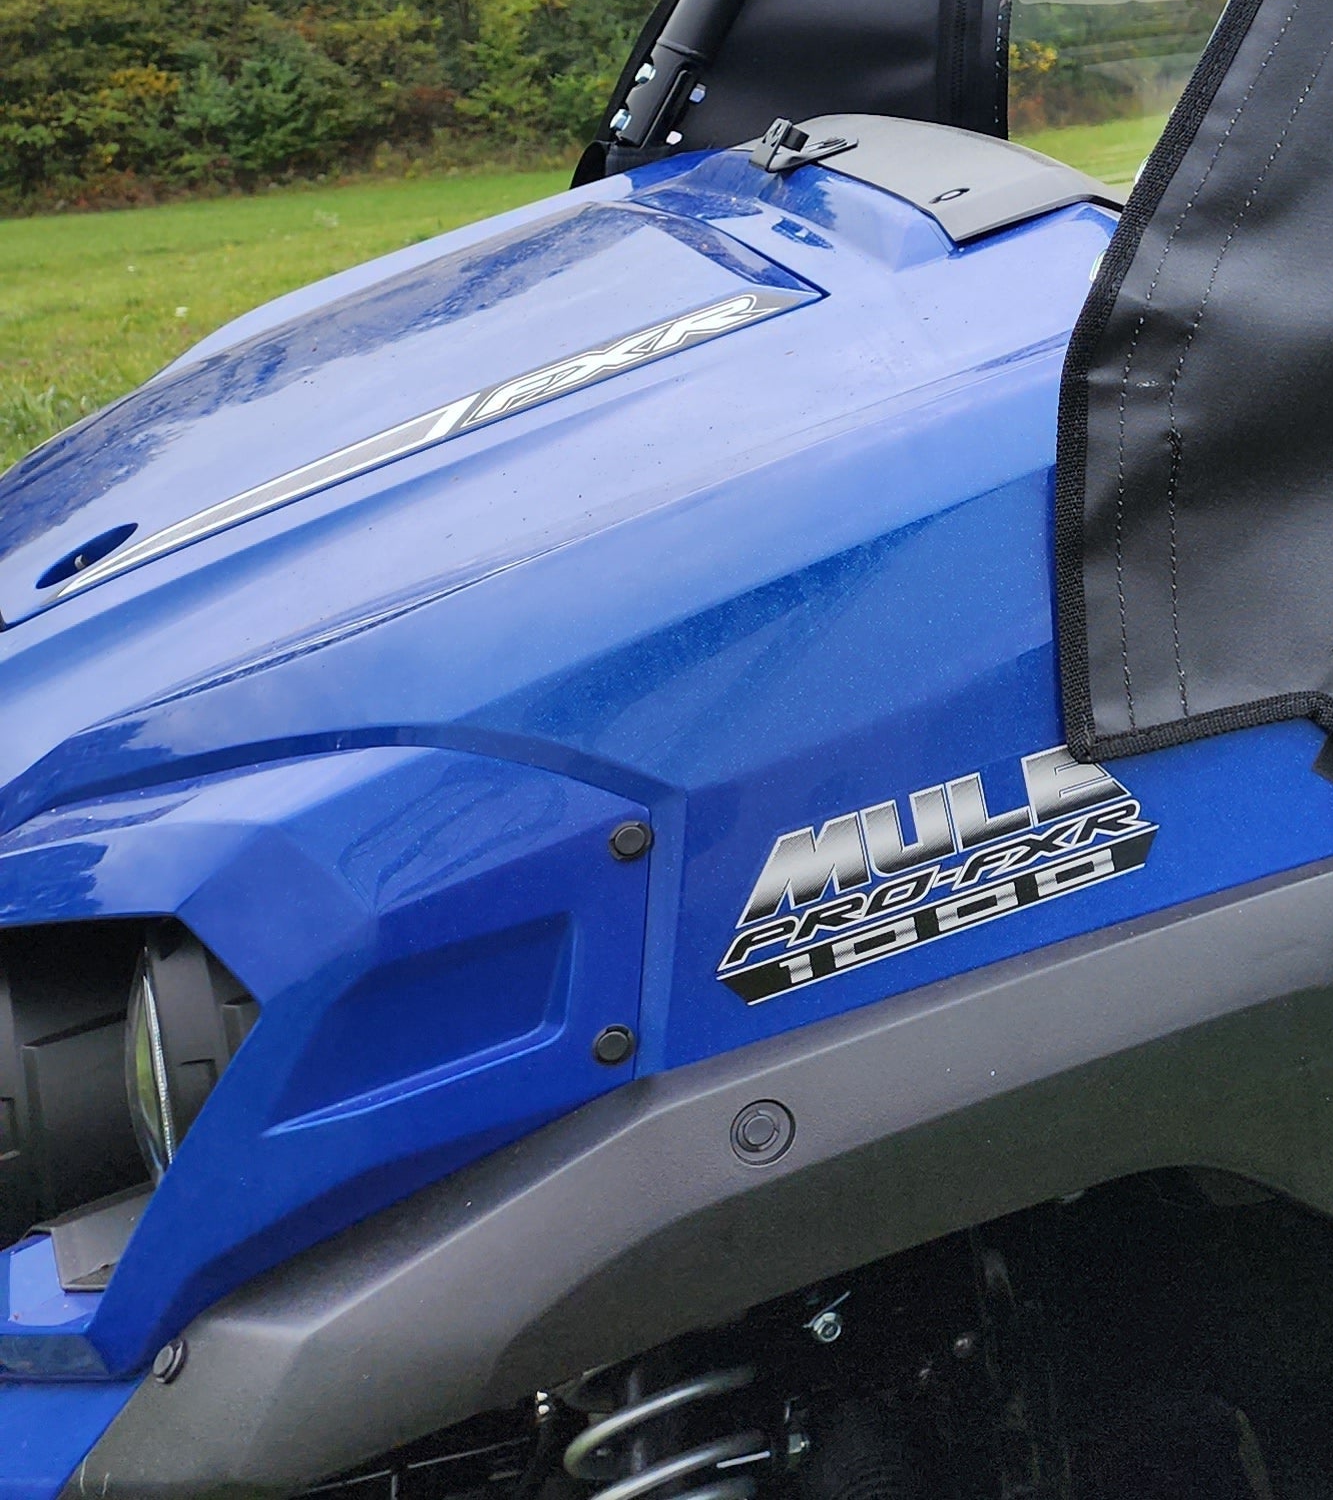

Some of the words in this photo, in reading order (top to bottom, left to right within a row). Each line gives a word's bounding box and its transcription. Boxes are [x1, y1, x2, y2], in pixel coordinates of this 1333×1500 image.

[461, 294, 778, 427] FXR
[717, 799, 1152, 971] PRO-FXR
[735, 744, 1132, 929] MULE
[779, 848, 1116, 985] 1000
